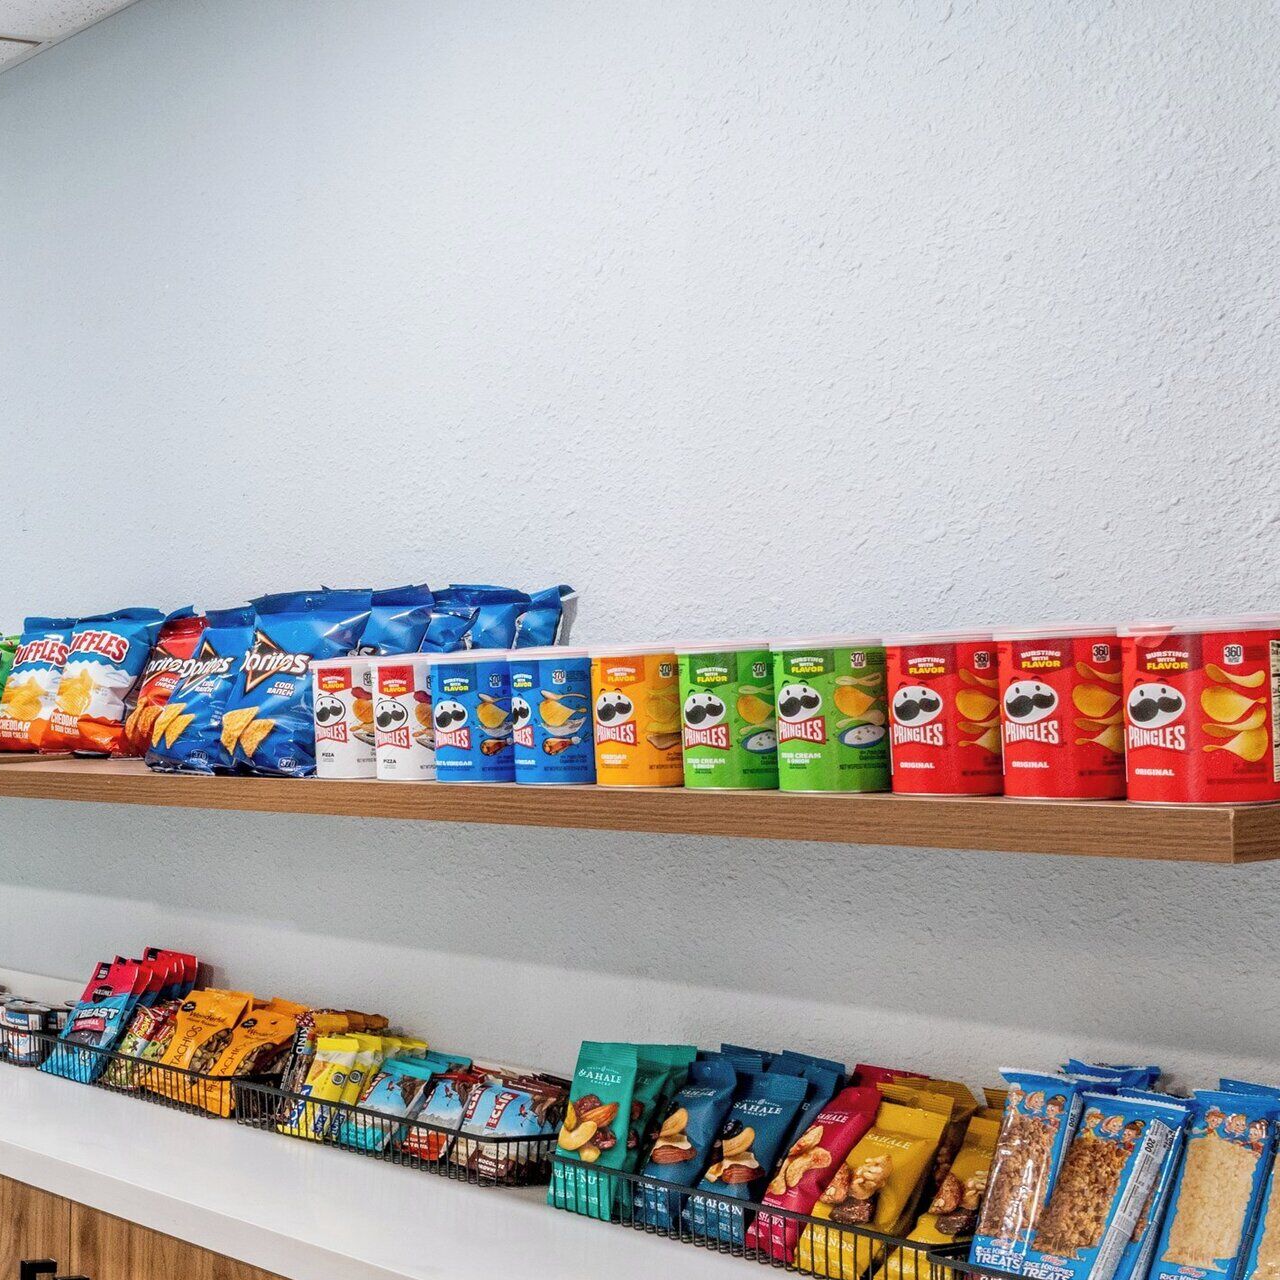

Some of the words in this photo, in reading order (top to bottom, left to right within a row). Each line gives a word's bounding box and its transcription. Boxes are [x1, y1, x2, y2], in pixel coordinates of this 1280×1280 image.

[851, 653, 865, 661] 370
[1094, 645, 1108, 656] 360
[1146, 651, 1189, 659] BURSTING
[1225, 646, 1241, 657] 360
[975, 653, 989, 662] 360
[1022, 660, 1060, 668] FLAVOR
[180, 657, 234, 678] Doritos
[753, 664, 766, 672] 370
[909, 667, 944, 675] FLAVOR
[1147, 662, 1188, 670] FLAVOR
[50, 713, 78, 728] CHEDDAR
[597, 724, 634, 743] PRINGLES
[779, 718, 822, 741] PRINGLES
[894, 724, 943, 746] PRINGLES
[1006, 721, 1059, 744] PRINGLES
[685, 726, 727, 747] PRINGLES
[1129, 725, 1185, 750] PRINGLES
[280, 759, 295, 767] 370
[295, 1026, 309, 1054] KIND
[734, 1103, 782, 1114] SAHALE
[818, 1114, 849, 1123] SAHALE
[1067, 1113, 1075, 1127] 200
[866, 1134, 912, 1149] SAHALE
[1144, 1139, 1156, 1152] 200
[976, 1253, 1022, 1269] TREATS
[1024, 1261, 1040, 1269] RICE
[1041, 1262, 1074, 1276] KRISPIES
